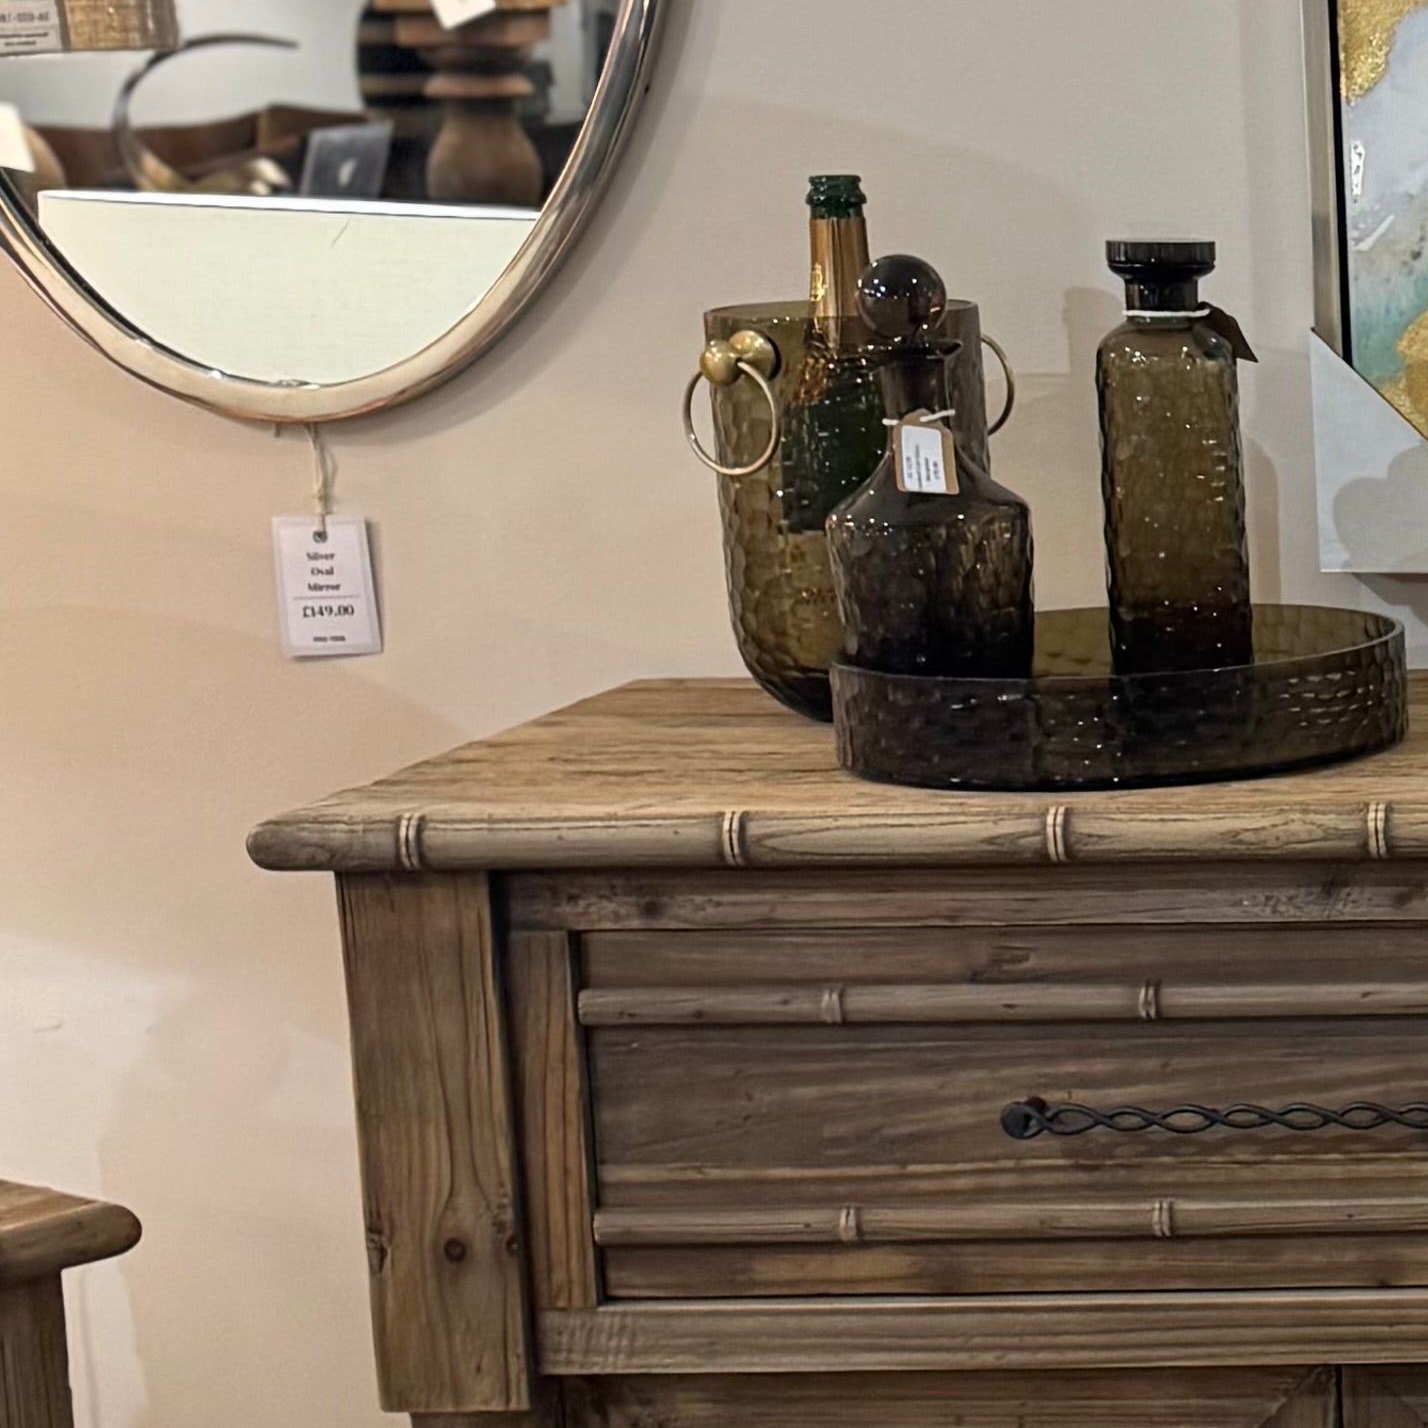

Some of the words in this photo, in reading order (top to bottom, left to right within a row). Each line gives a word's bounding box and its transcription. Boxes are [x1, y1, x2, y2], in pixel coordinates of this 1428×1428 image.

[306, 552, 336, 561] Silver
[310, 566, 335, 576] Oval
[307, 582, 342, 592] Mirror
[302, 603, 356, 619] £149.00
